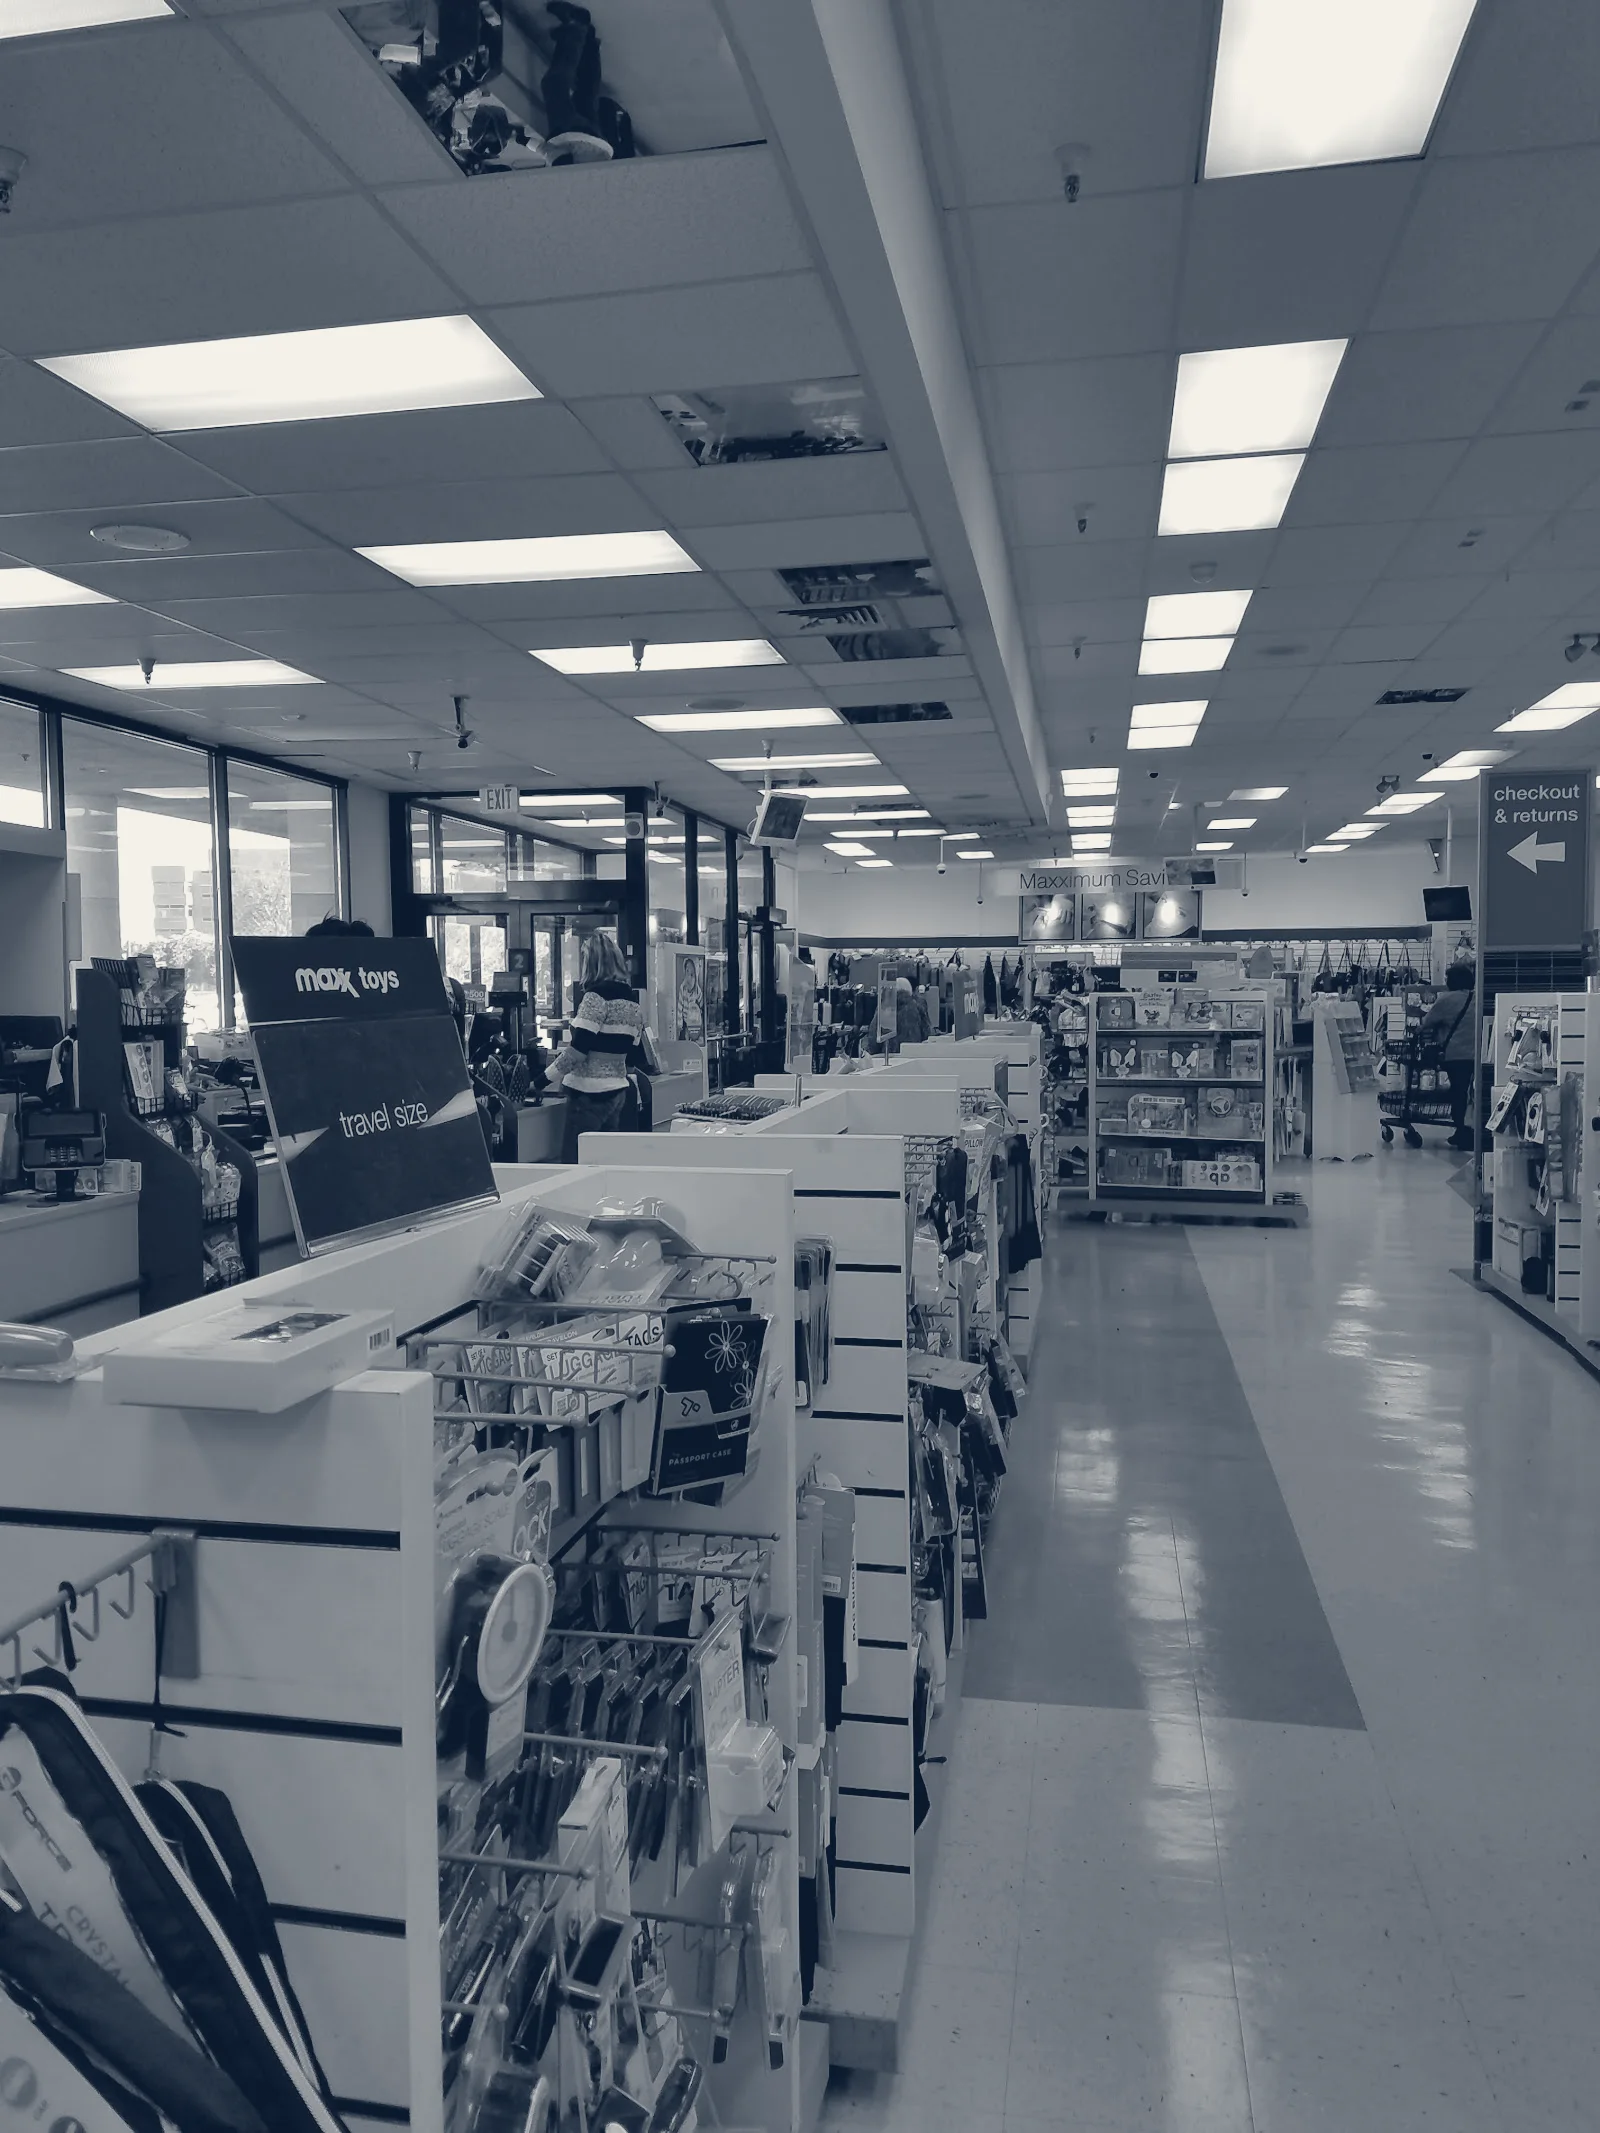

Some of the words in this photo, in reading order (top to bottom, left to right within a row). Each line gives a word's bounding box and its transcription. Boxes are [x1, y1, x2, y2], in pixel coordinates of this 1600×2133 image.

[486, 788, 512, 810] EXIT
[1494, 784, 1580, 801] checkout
[1494, 808, 1508, 824] &
[1513, 808, 1579, 823] returns
[1020, 872, 1126, 890] Maxximum
[513, 953, 524, 969] 2
[295, 967, 360, 998] maxx
[358, 967, 400, 994] toys
[339, 1102, 392, 1138] travel
[394, 1099, 428, 1128] size
[546, 1351, 559, 1362] SET
[668, 1452, 711, 1467] PASSPORT
[712, 1448, 732, 1459] CASE
[513, 1504, 548, 1557] OCK
